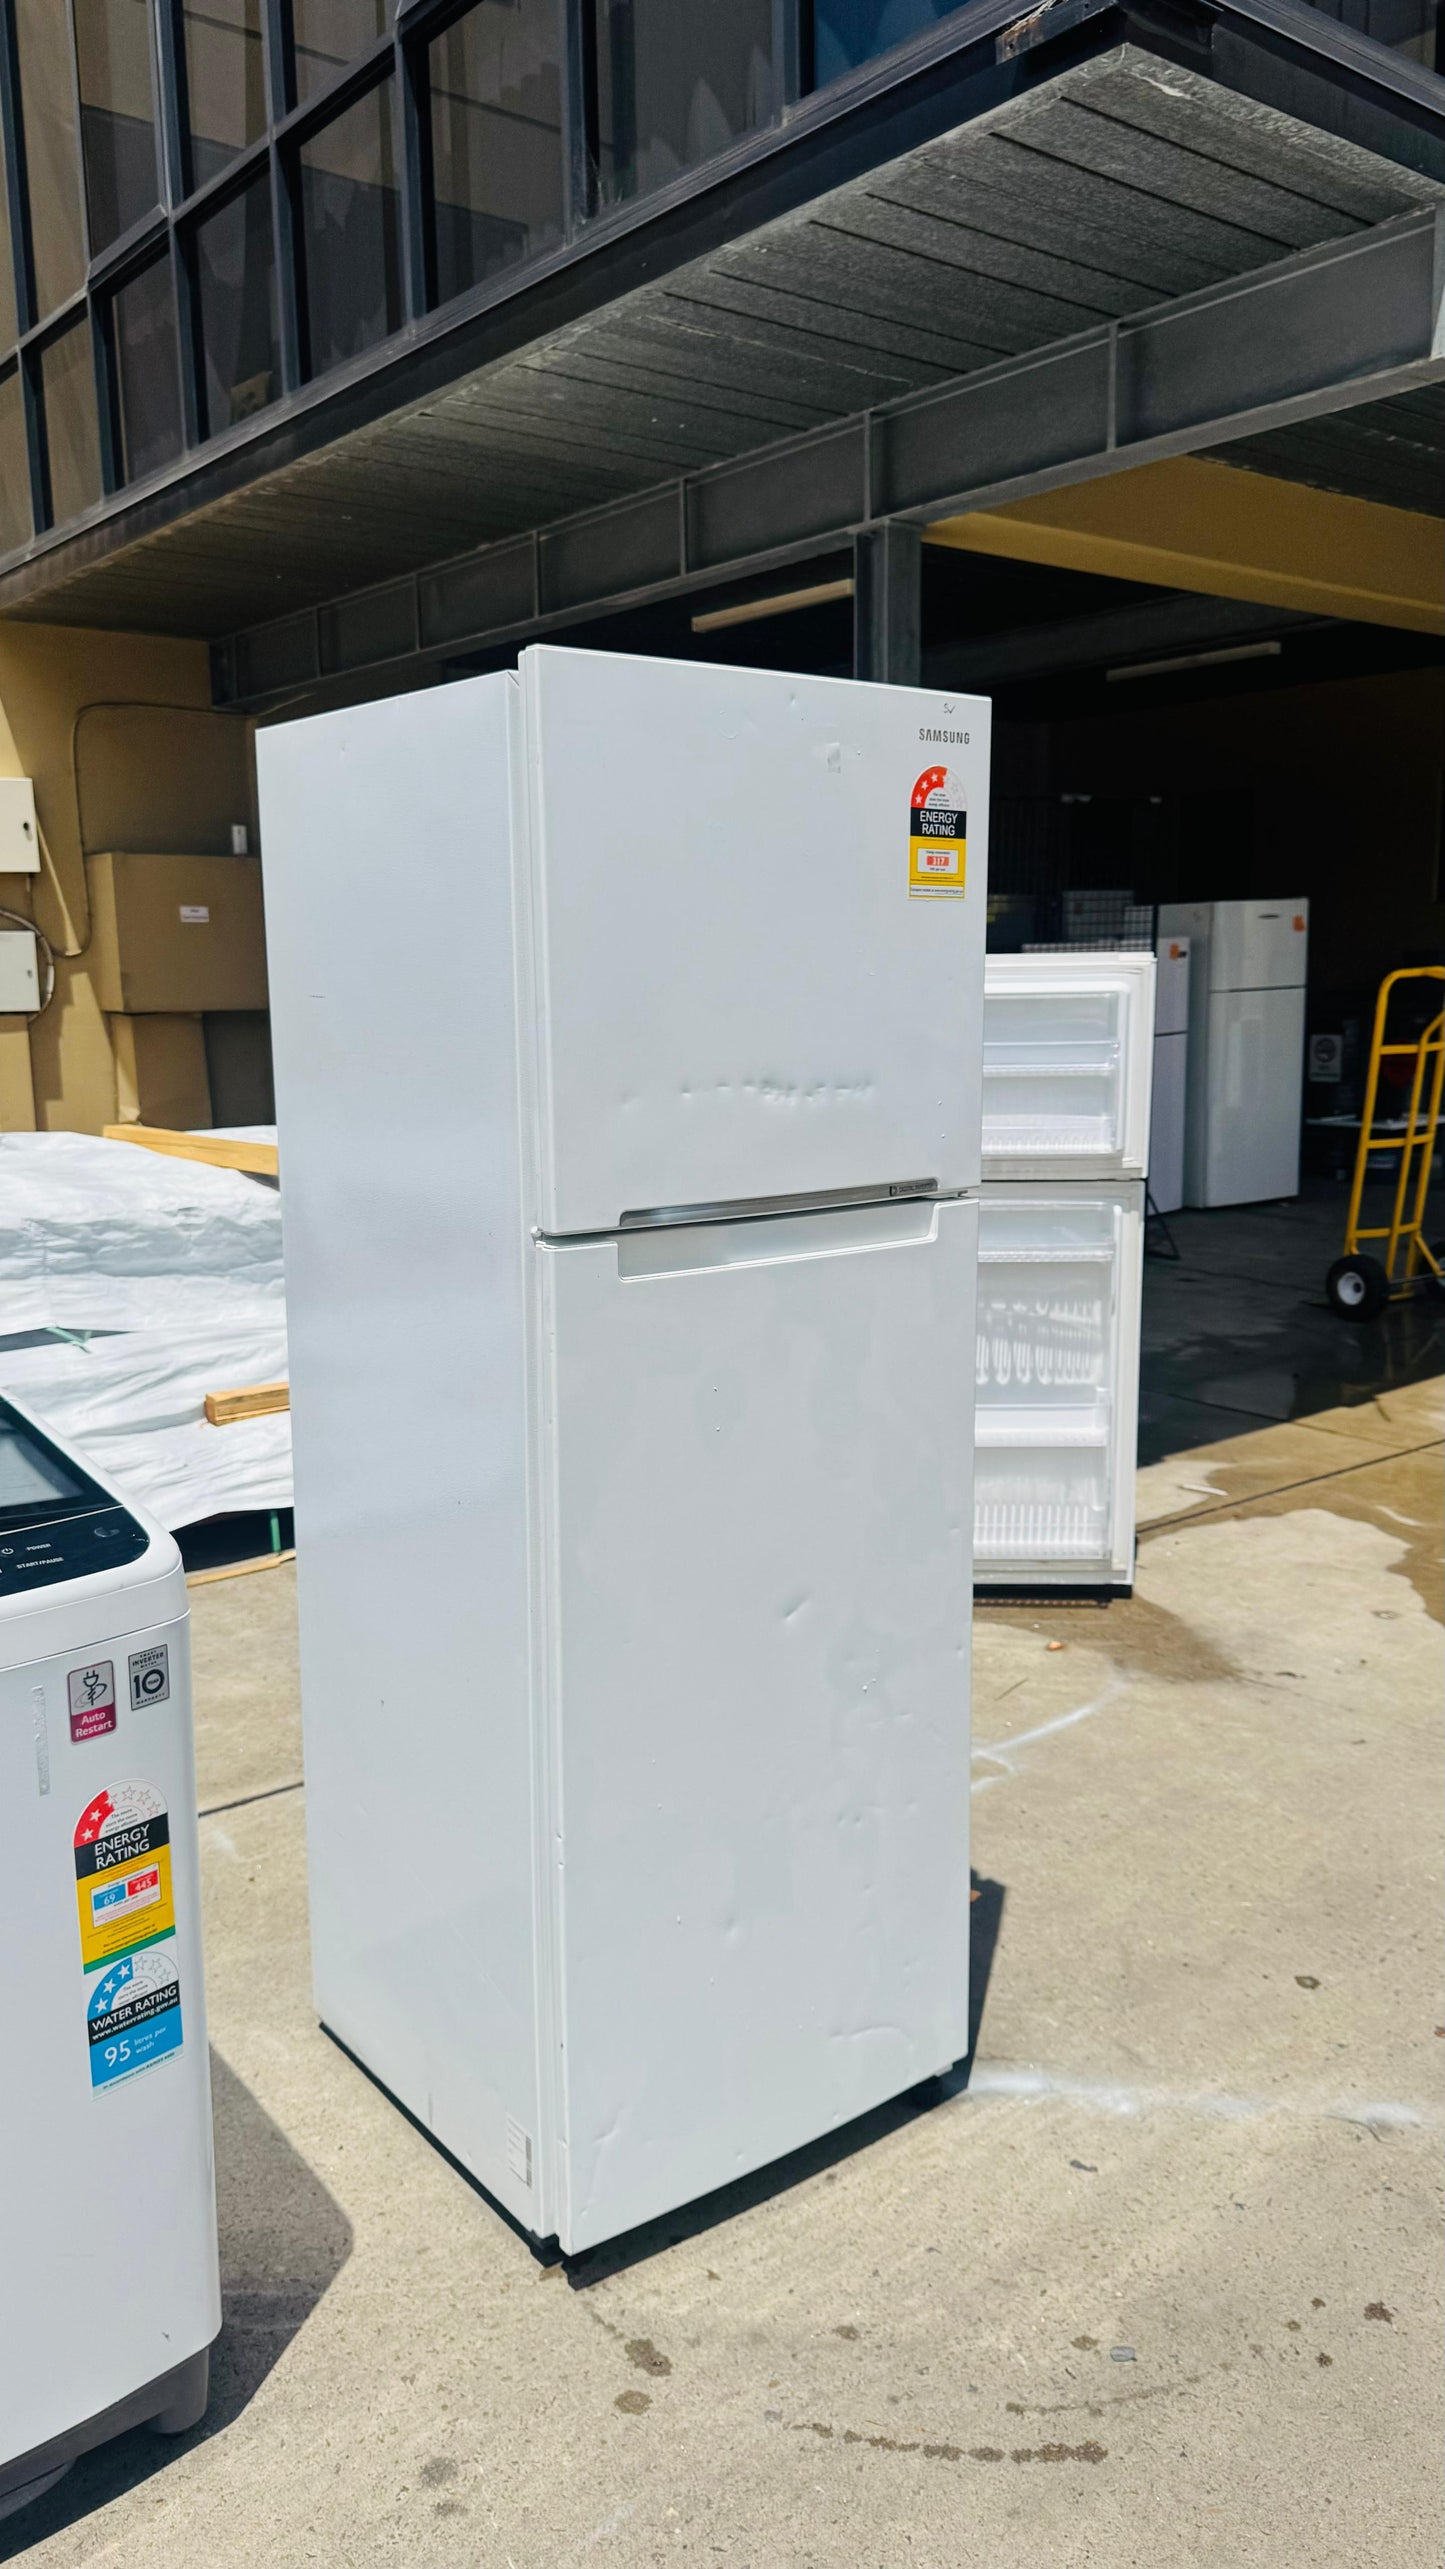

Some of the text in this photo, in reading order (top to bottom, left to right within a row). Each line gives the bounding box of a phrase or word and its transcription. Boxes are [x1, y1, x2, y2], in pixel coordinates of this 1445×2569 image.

[918, 728, 970, 745] SAMSUNG
[919, 810, 958, 824] ENERGY
[921, 823, 956, 836] RATING
[16, 1556, 64, 1569] START/PAUSE
[132, 1652, 164, 1667] INVERTER
[133, 1668, 165, 1699] 10
[81, 1711, 106, 1725] Auto
[75, 1720, 113, 1738] Restart
[94, 1824, 150, 1856] ENERGY
[96, 1838, 150, 1869] RATING
[135, 1878, 152, 1891] 445
[104, 1893, 116, 1905] 69
[92, 2006, 133, 2031] WATER
[135, 1985, 177, 2013] RATING
[92, 1997, 178, 2041] www.waterrating.gov.au
[154, 2026, 167, 2038] per
[104, 2039, 131, 2067] 95
[136, 2041, 155, 2054] wash
